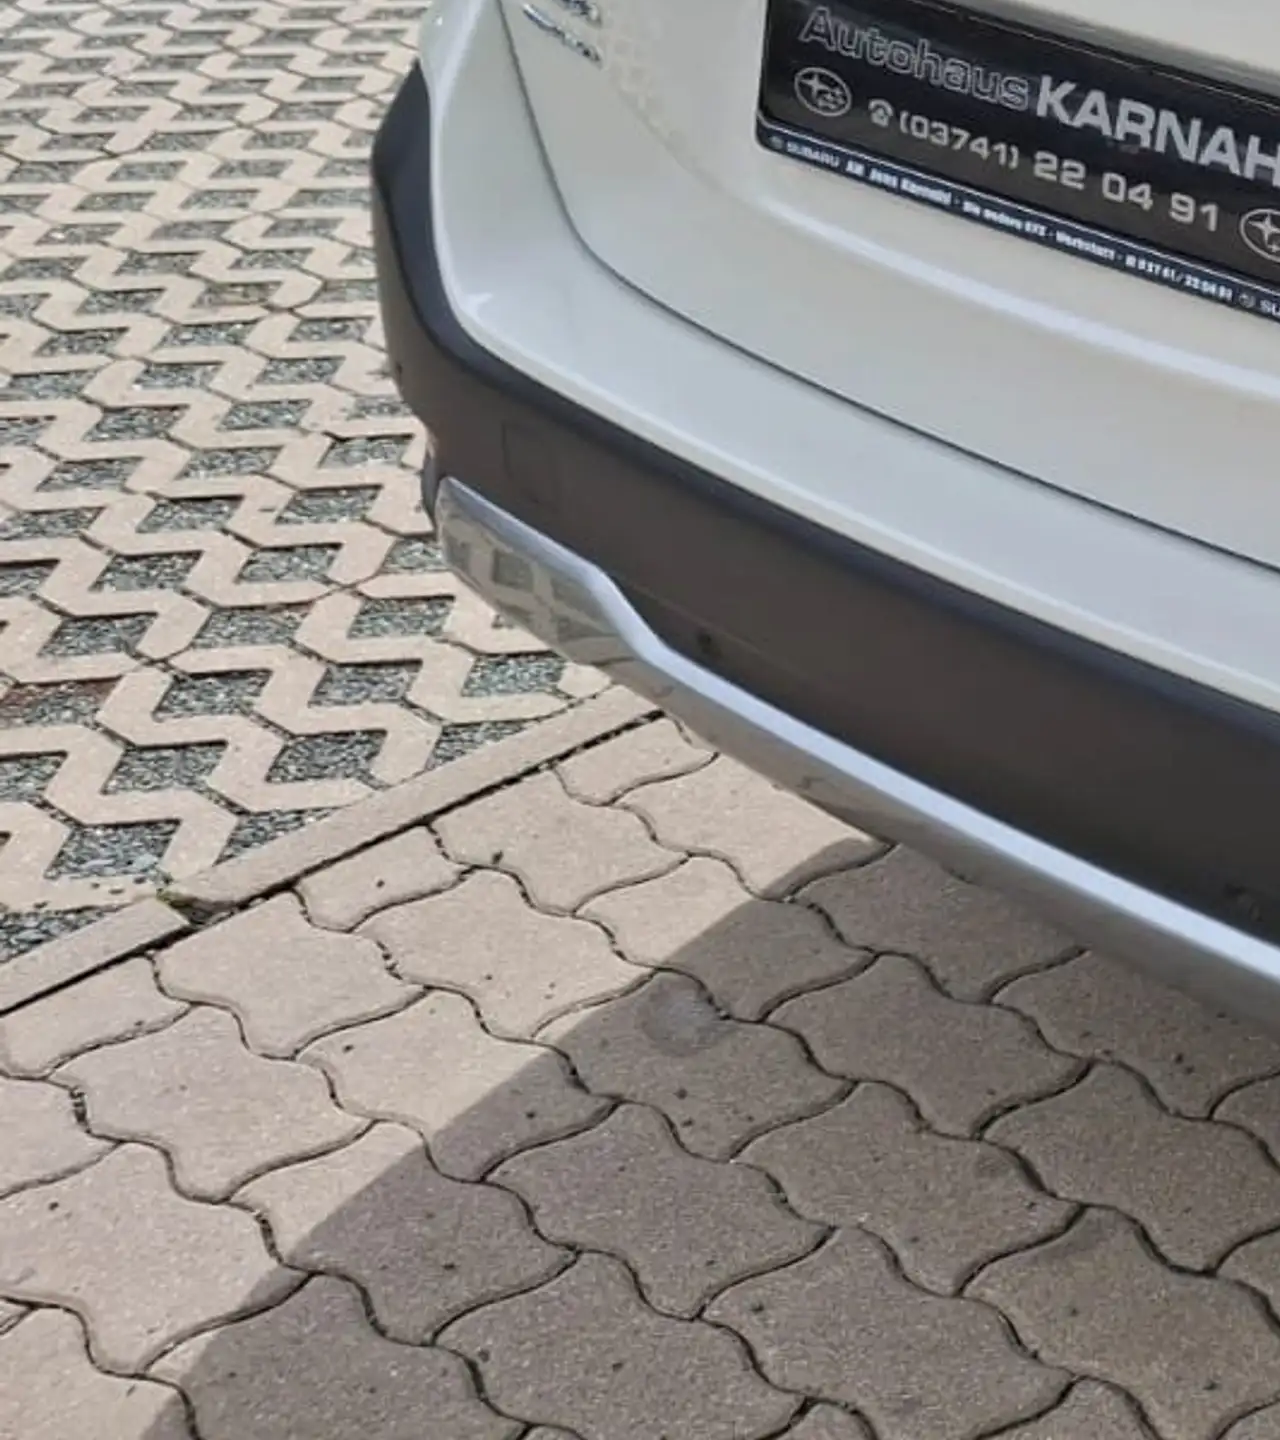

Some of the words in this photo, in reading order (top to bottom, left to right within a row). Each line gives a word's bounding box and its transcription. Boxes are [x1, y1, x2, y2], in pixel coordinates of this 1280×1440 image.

[801, 6, 1029, 112] Autohaus
[900, 111, 1018, 169] (03741)
[1032, 150, 1088, 192] 22
[1101, 170, 1155, 213] 04
[1169, 193, 1219, 233] 91
